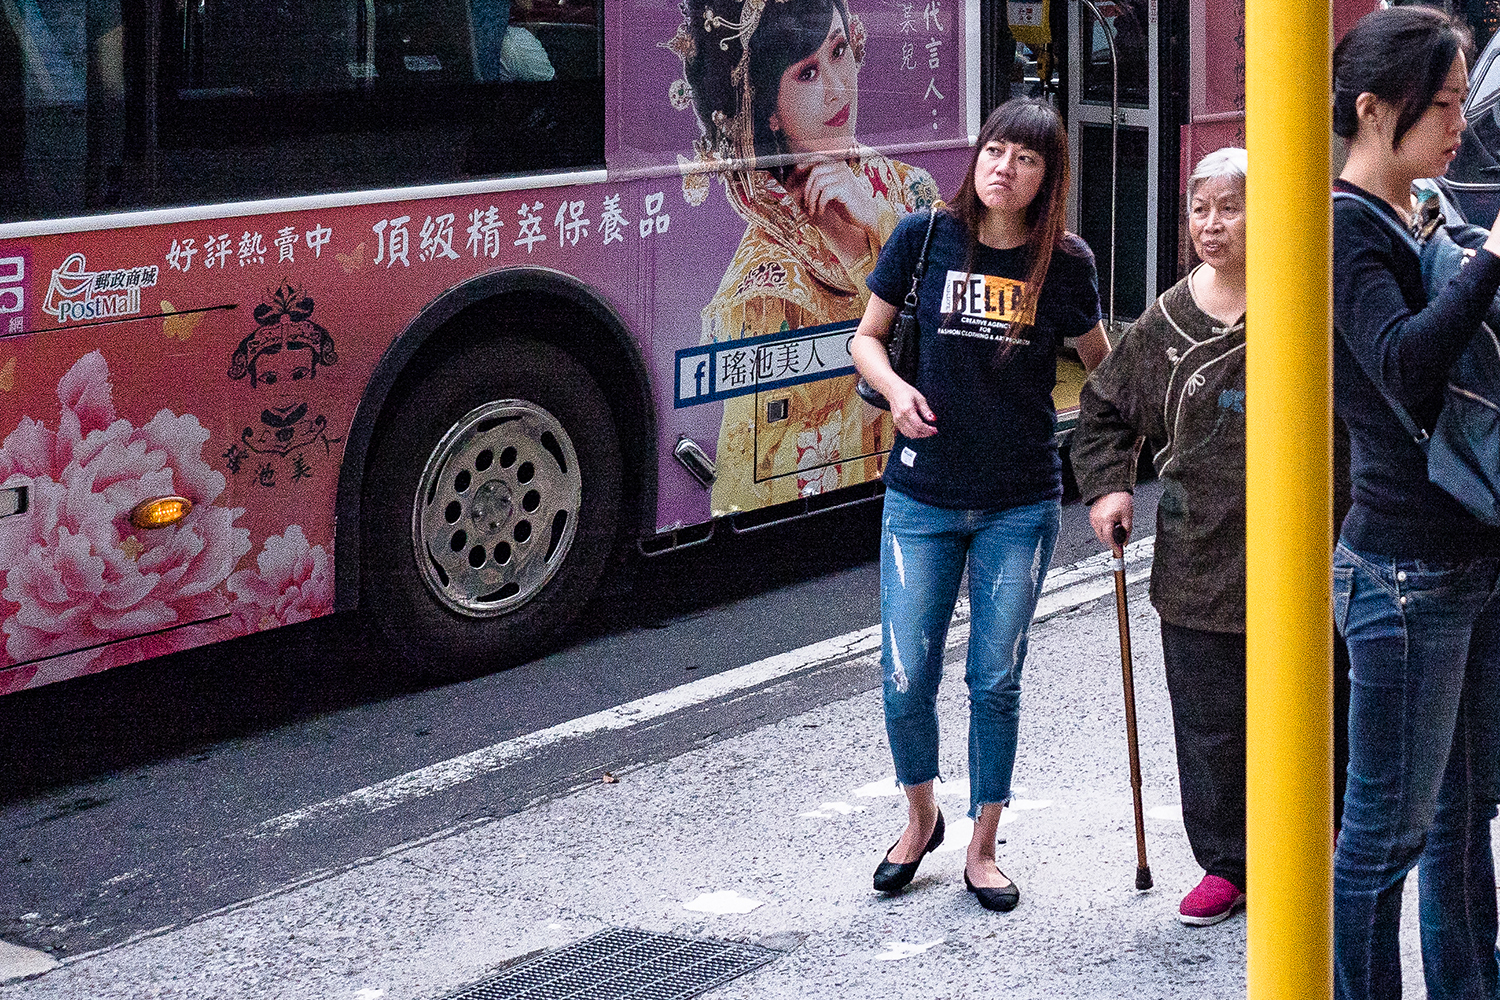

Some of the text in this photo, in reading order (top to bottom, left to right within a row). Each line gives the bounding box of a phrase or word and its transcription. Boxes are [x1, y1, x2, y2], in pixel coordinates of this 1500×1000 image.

[165, 222, 333, 272] 好評熱賣中
[372, 191, 671, 269] 頂級精萃保養品
[94, 266, 157, 291] 郵政商城
[721, 338, 826, 387] 瑤池美人
